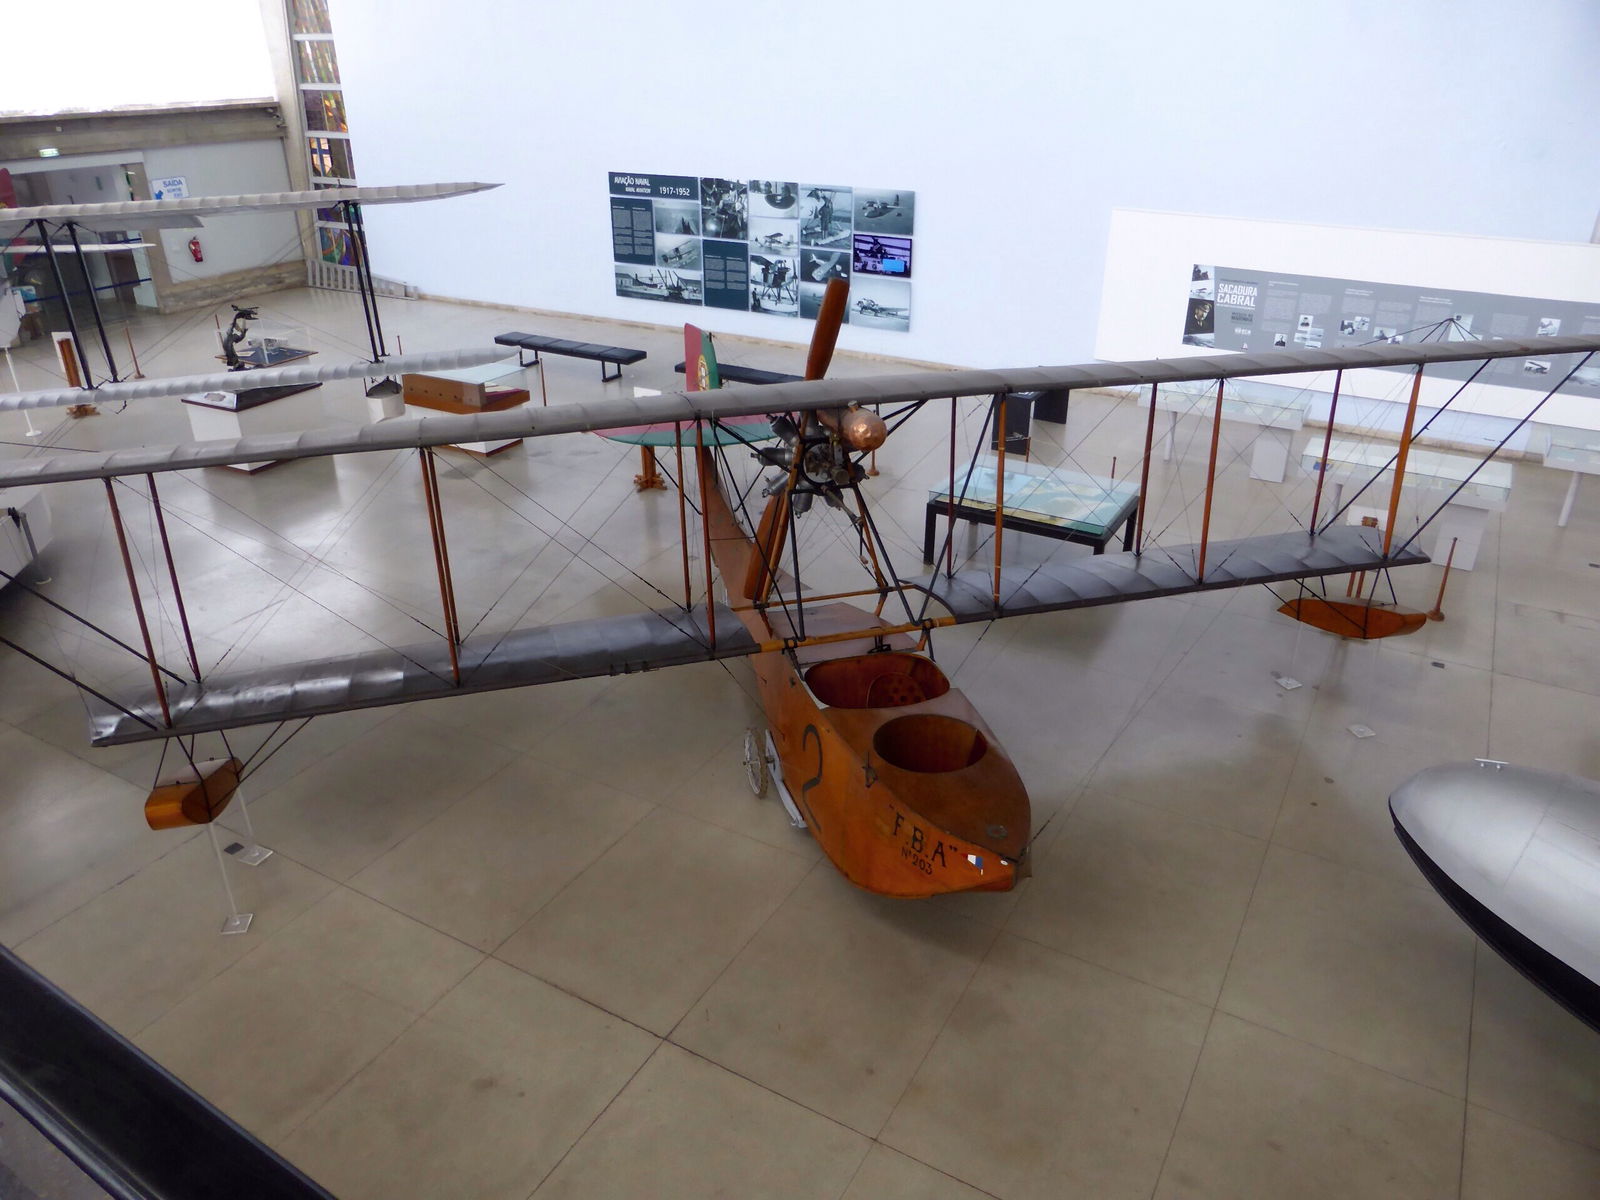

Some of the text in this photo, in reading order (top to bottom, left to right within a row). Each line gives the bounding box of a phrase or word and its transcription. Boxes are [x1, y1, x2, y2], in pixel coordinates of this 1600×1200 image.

[659, 186, 690, 196] 1917-1952
[1218, 283, 1258, 297] SACADURA
[1217, 292, 1256, 307] CABRAL
[913, 853, 933, 875] 203
